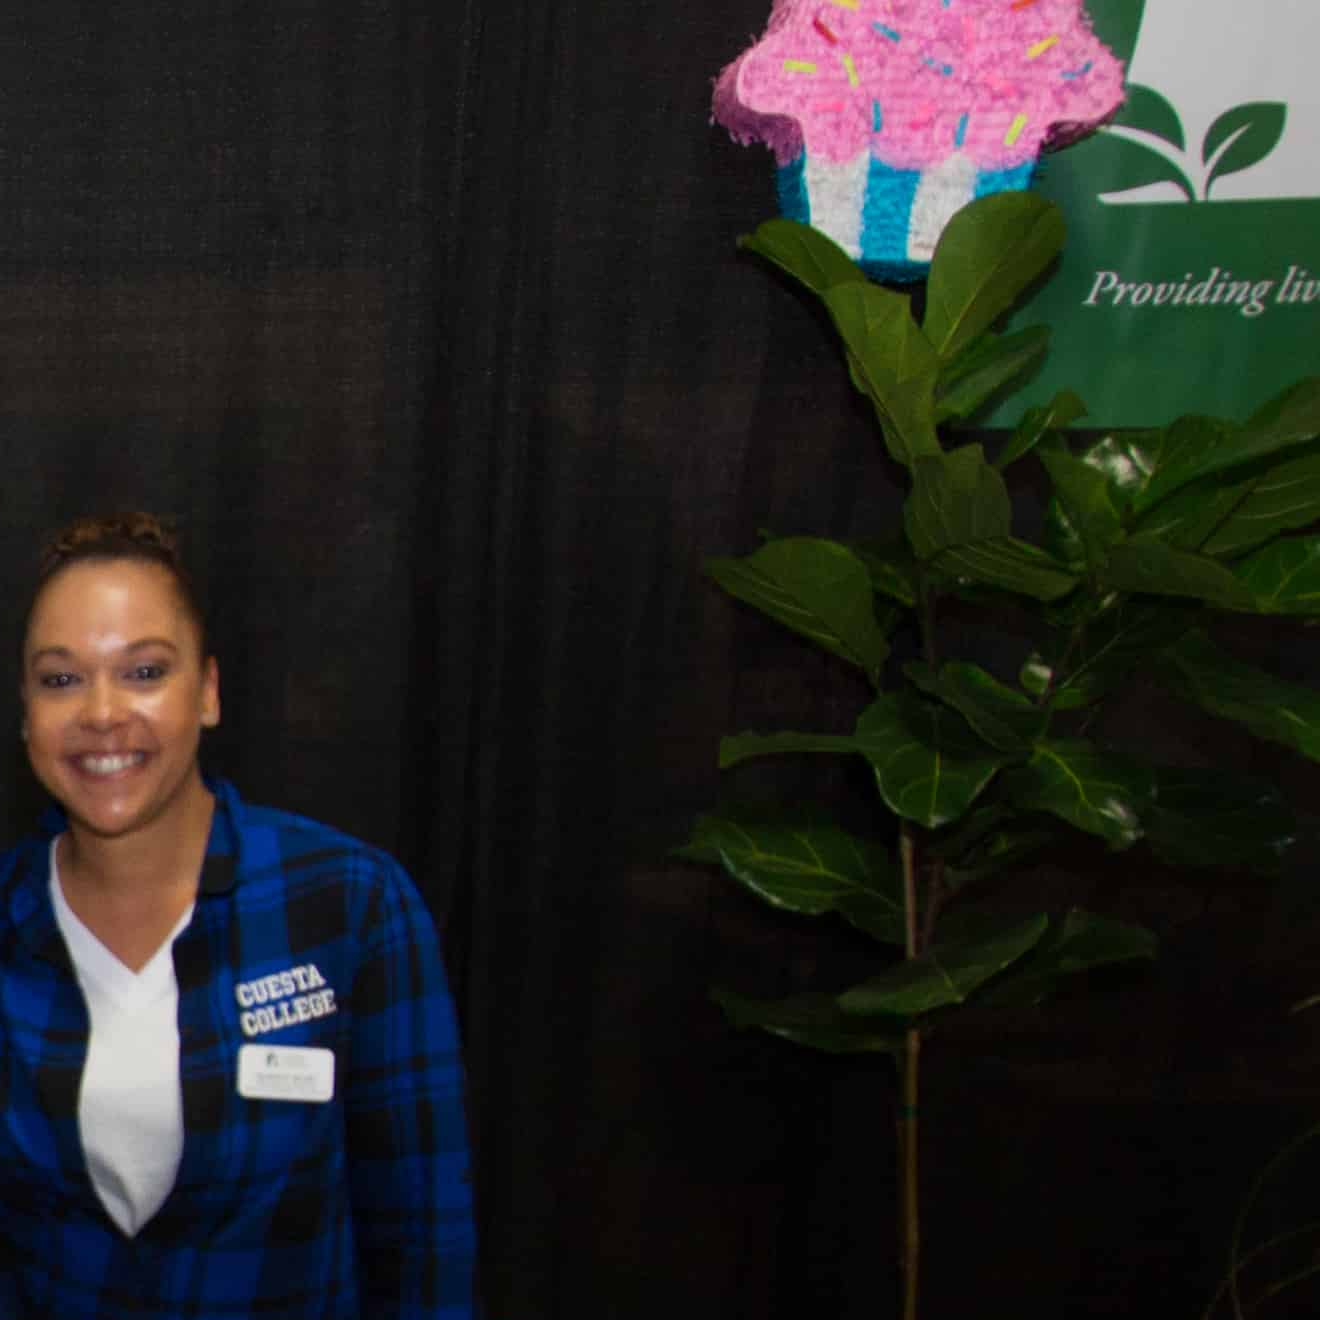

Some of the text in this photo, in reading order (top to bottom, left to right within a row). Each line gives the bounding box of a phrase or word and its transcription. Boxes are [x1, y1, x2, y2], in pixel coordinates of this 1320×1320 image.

[1084, 268, 1266, 315] Providing
[236, 963, 327, 1008] CUESTA
[240, 988, 338, 1036] COLLEGE
